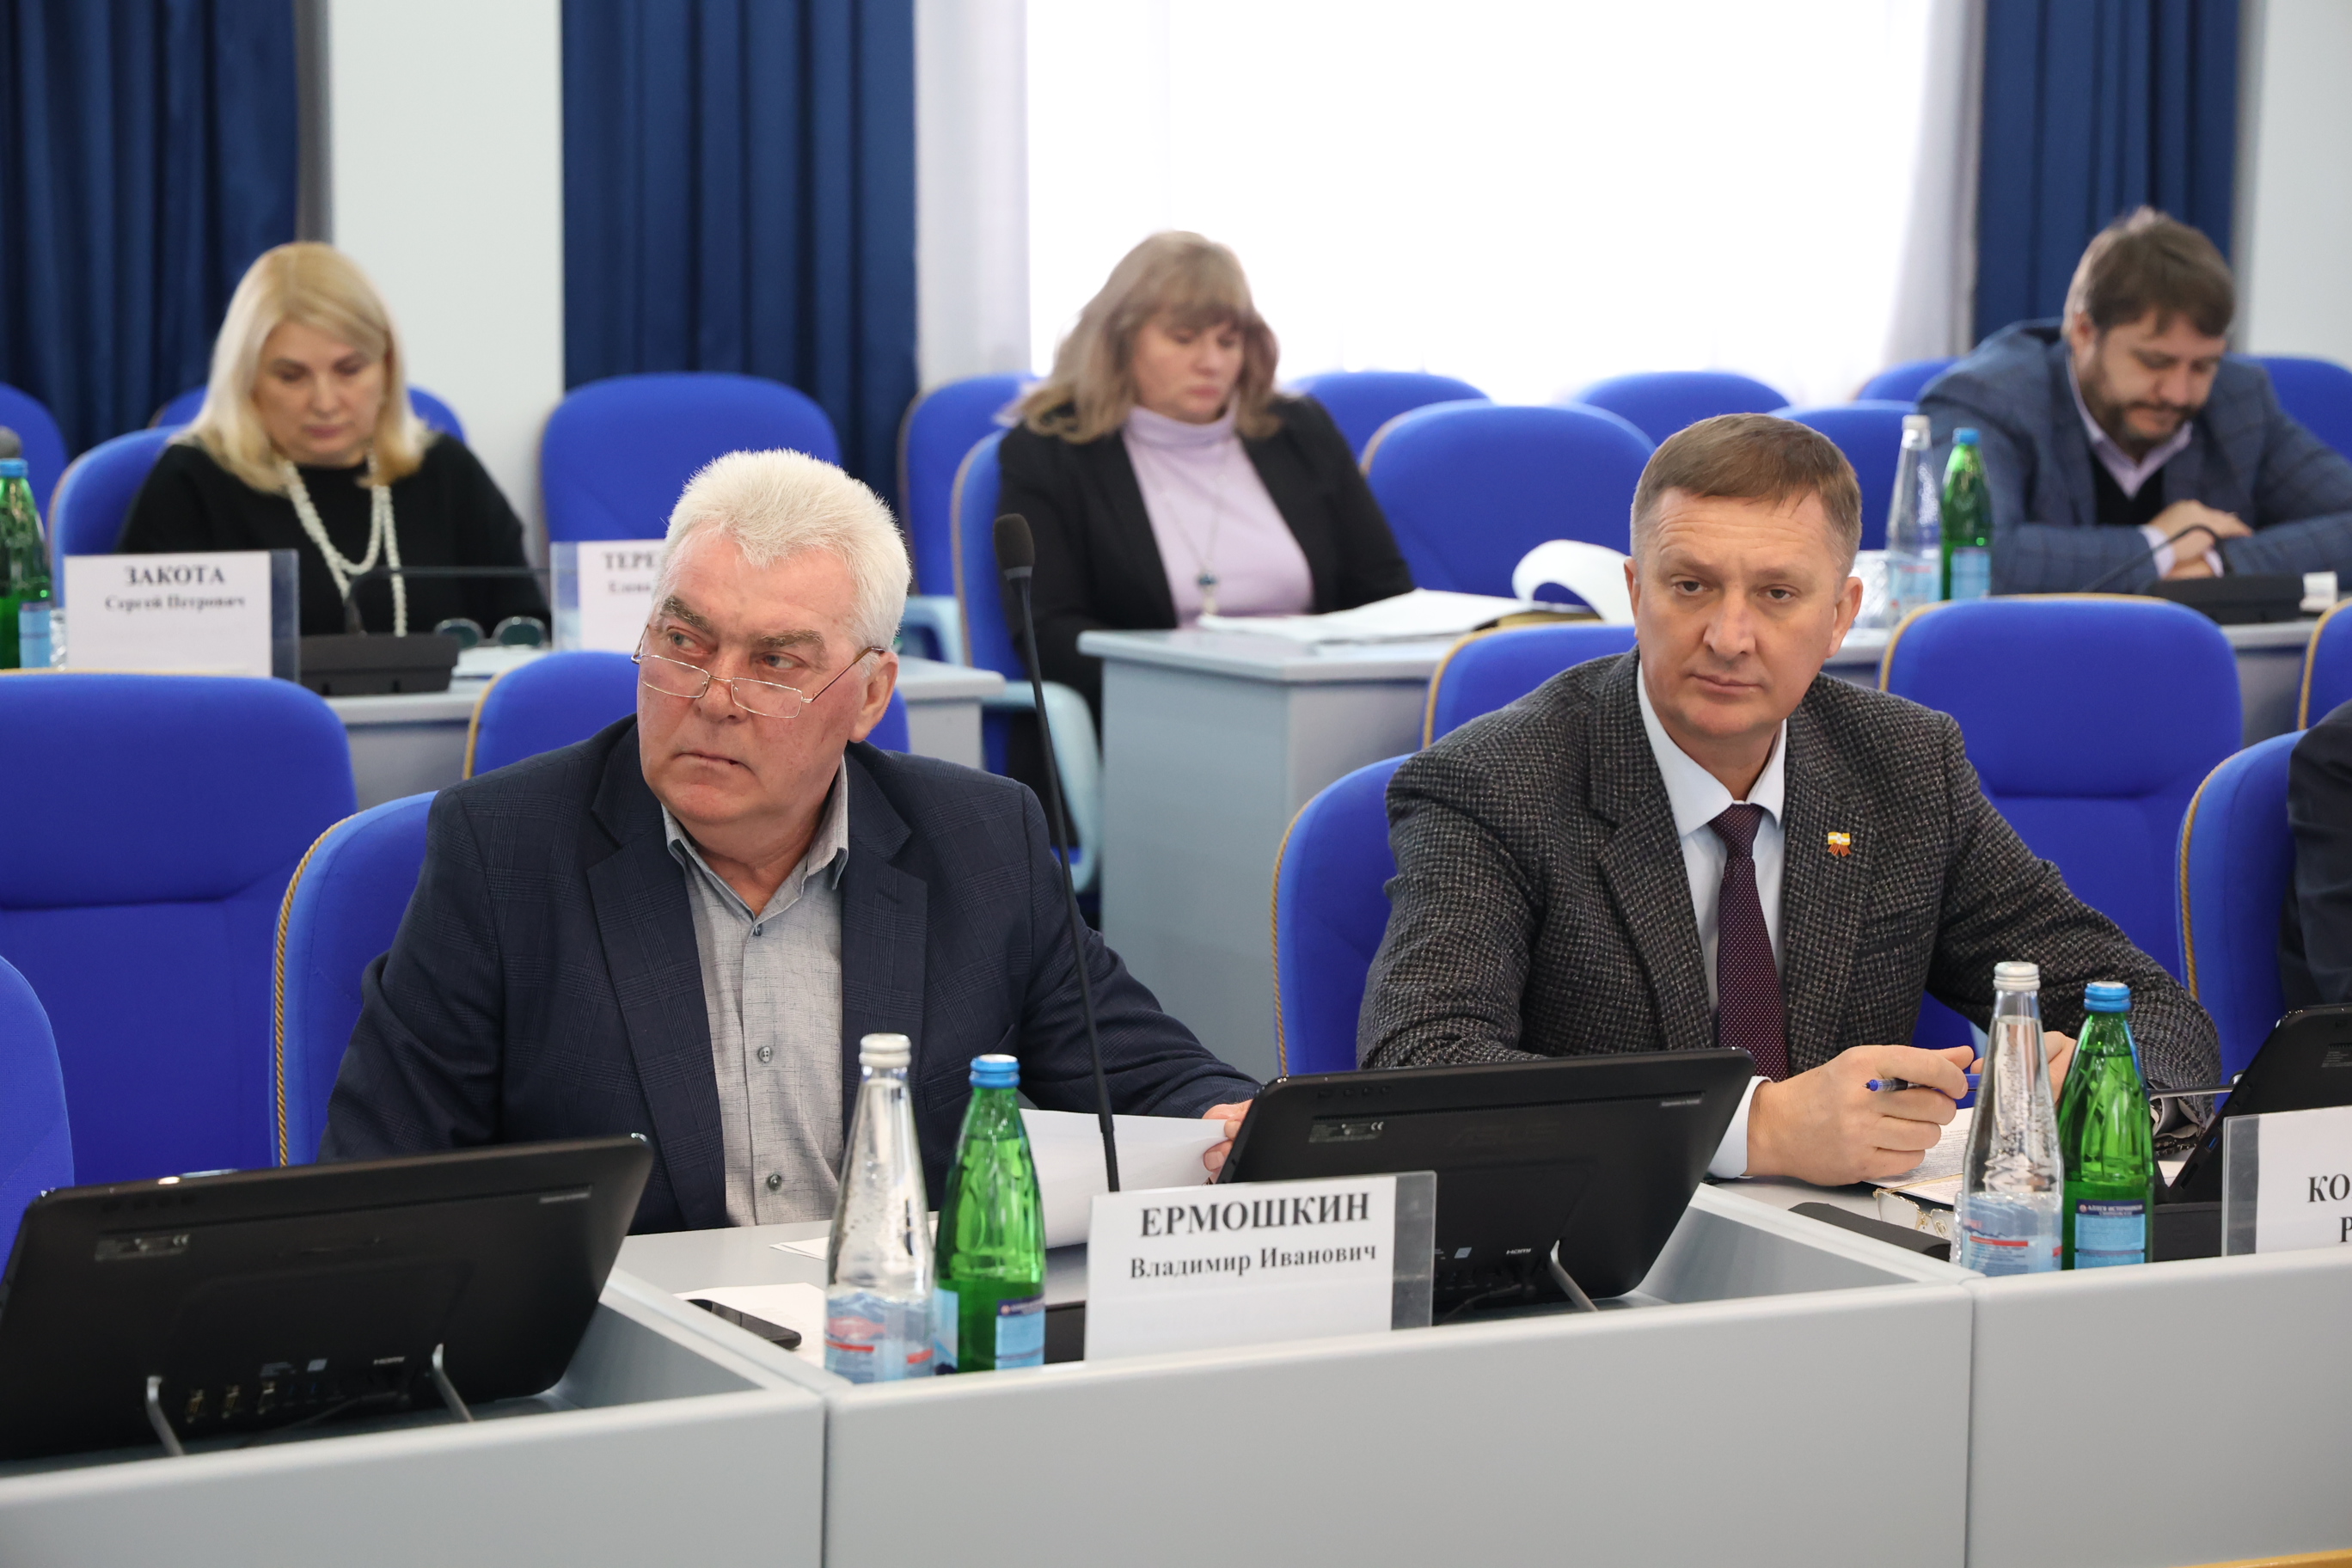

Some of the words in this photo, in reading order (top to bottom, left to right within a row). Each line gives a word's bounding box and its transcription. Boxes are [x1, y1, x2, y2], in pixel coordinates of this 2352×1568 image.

[124, 564, 225, 585] ЗАКОТА
[105, 595, 162, 614] Сергей
[167, 594, 245, 612] Петрович
[2307, 1173, 2352, 1203] КО
[1141, 1192, 1371, 1238] ЕРМОШКИН
[1130, 1253, 1251, 1279] Владимир
[1260, 1245, 1376, 1269] Иванович
